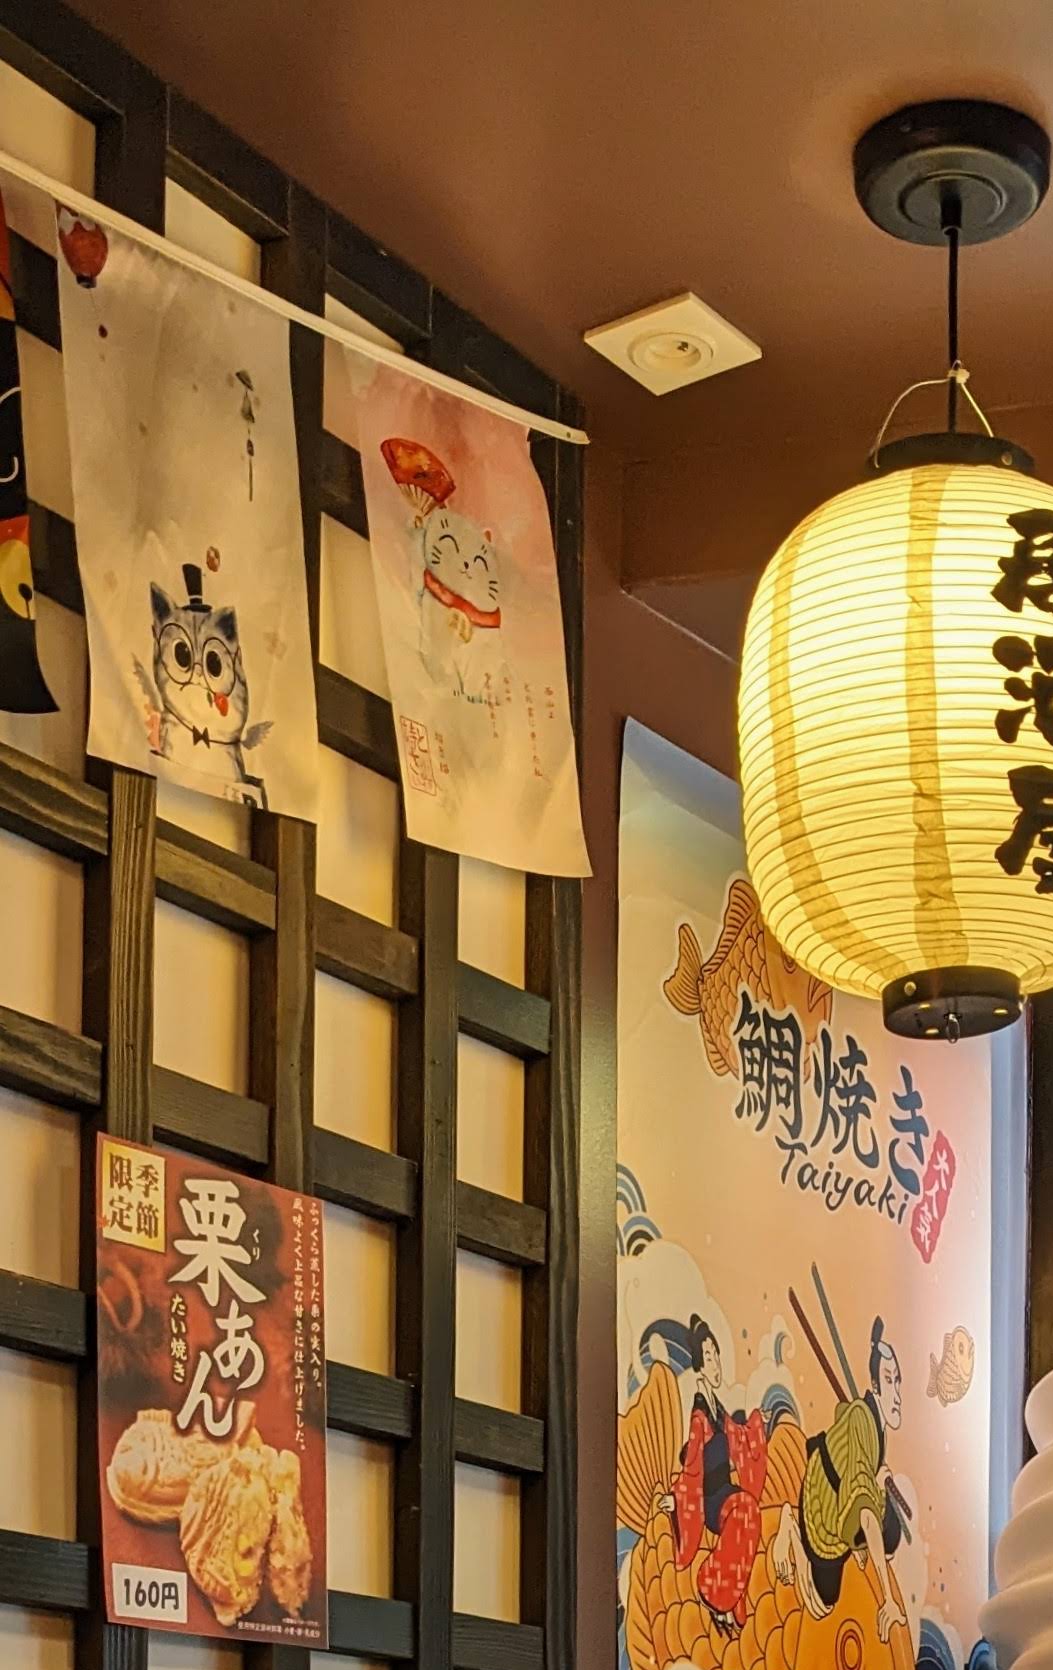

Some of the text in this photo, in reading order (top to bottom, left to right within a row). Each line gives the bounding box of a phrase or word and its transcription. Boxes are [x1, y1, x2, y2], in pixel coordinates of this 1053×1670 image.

[733, 990, 929, 1196] 鯛焼き
[775, 1136, 910, 1225] Taiyaki
[168, 1179, 268, 1438] 栗あん
[169, 1293, 188, 1383] たい焼き
[122, 1577, 180, 1611] 160円
